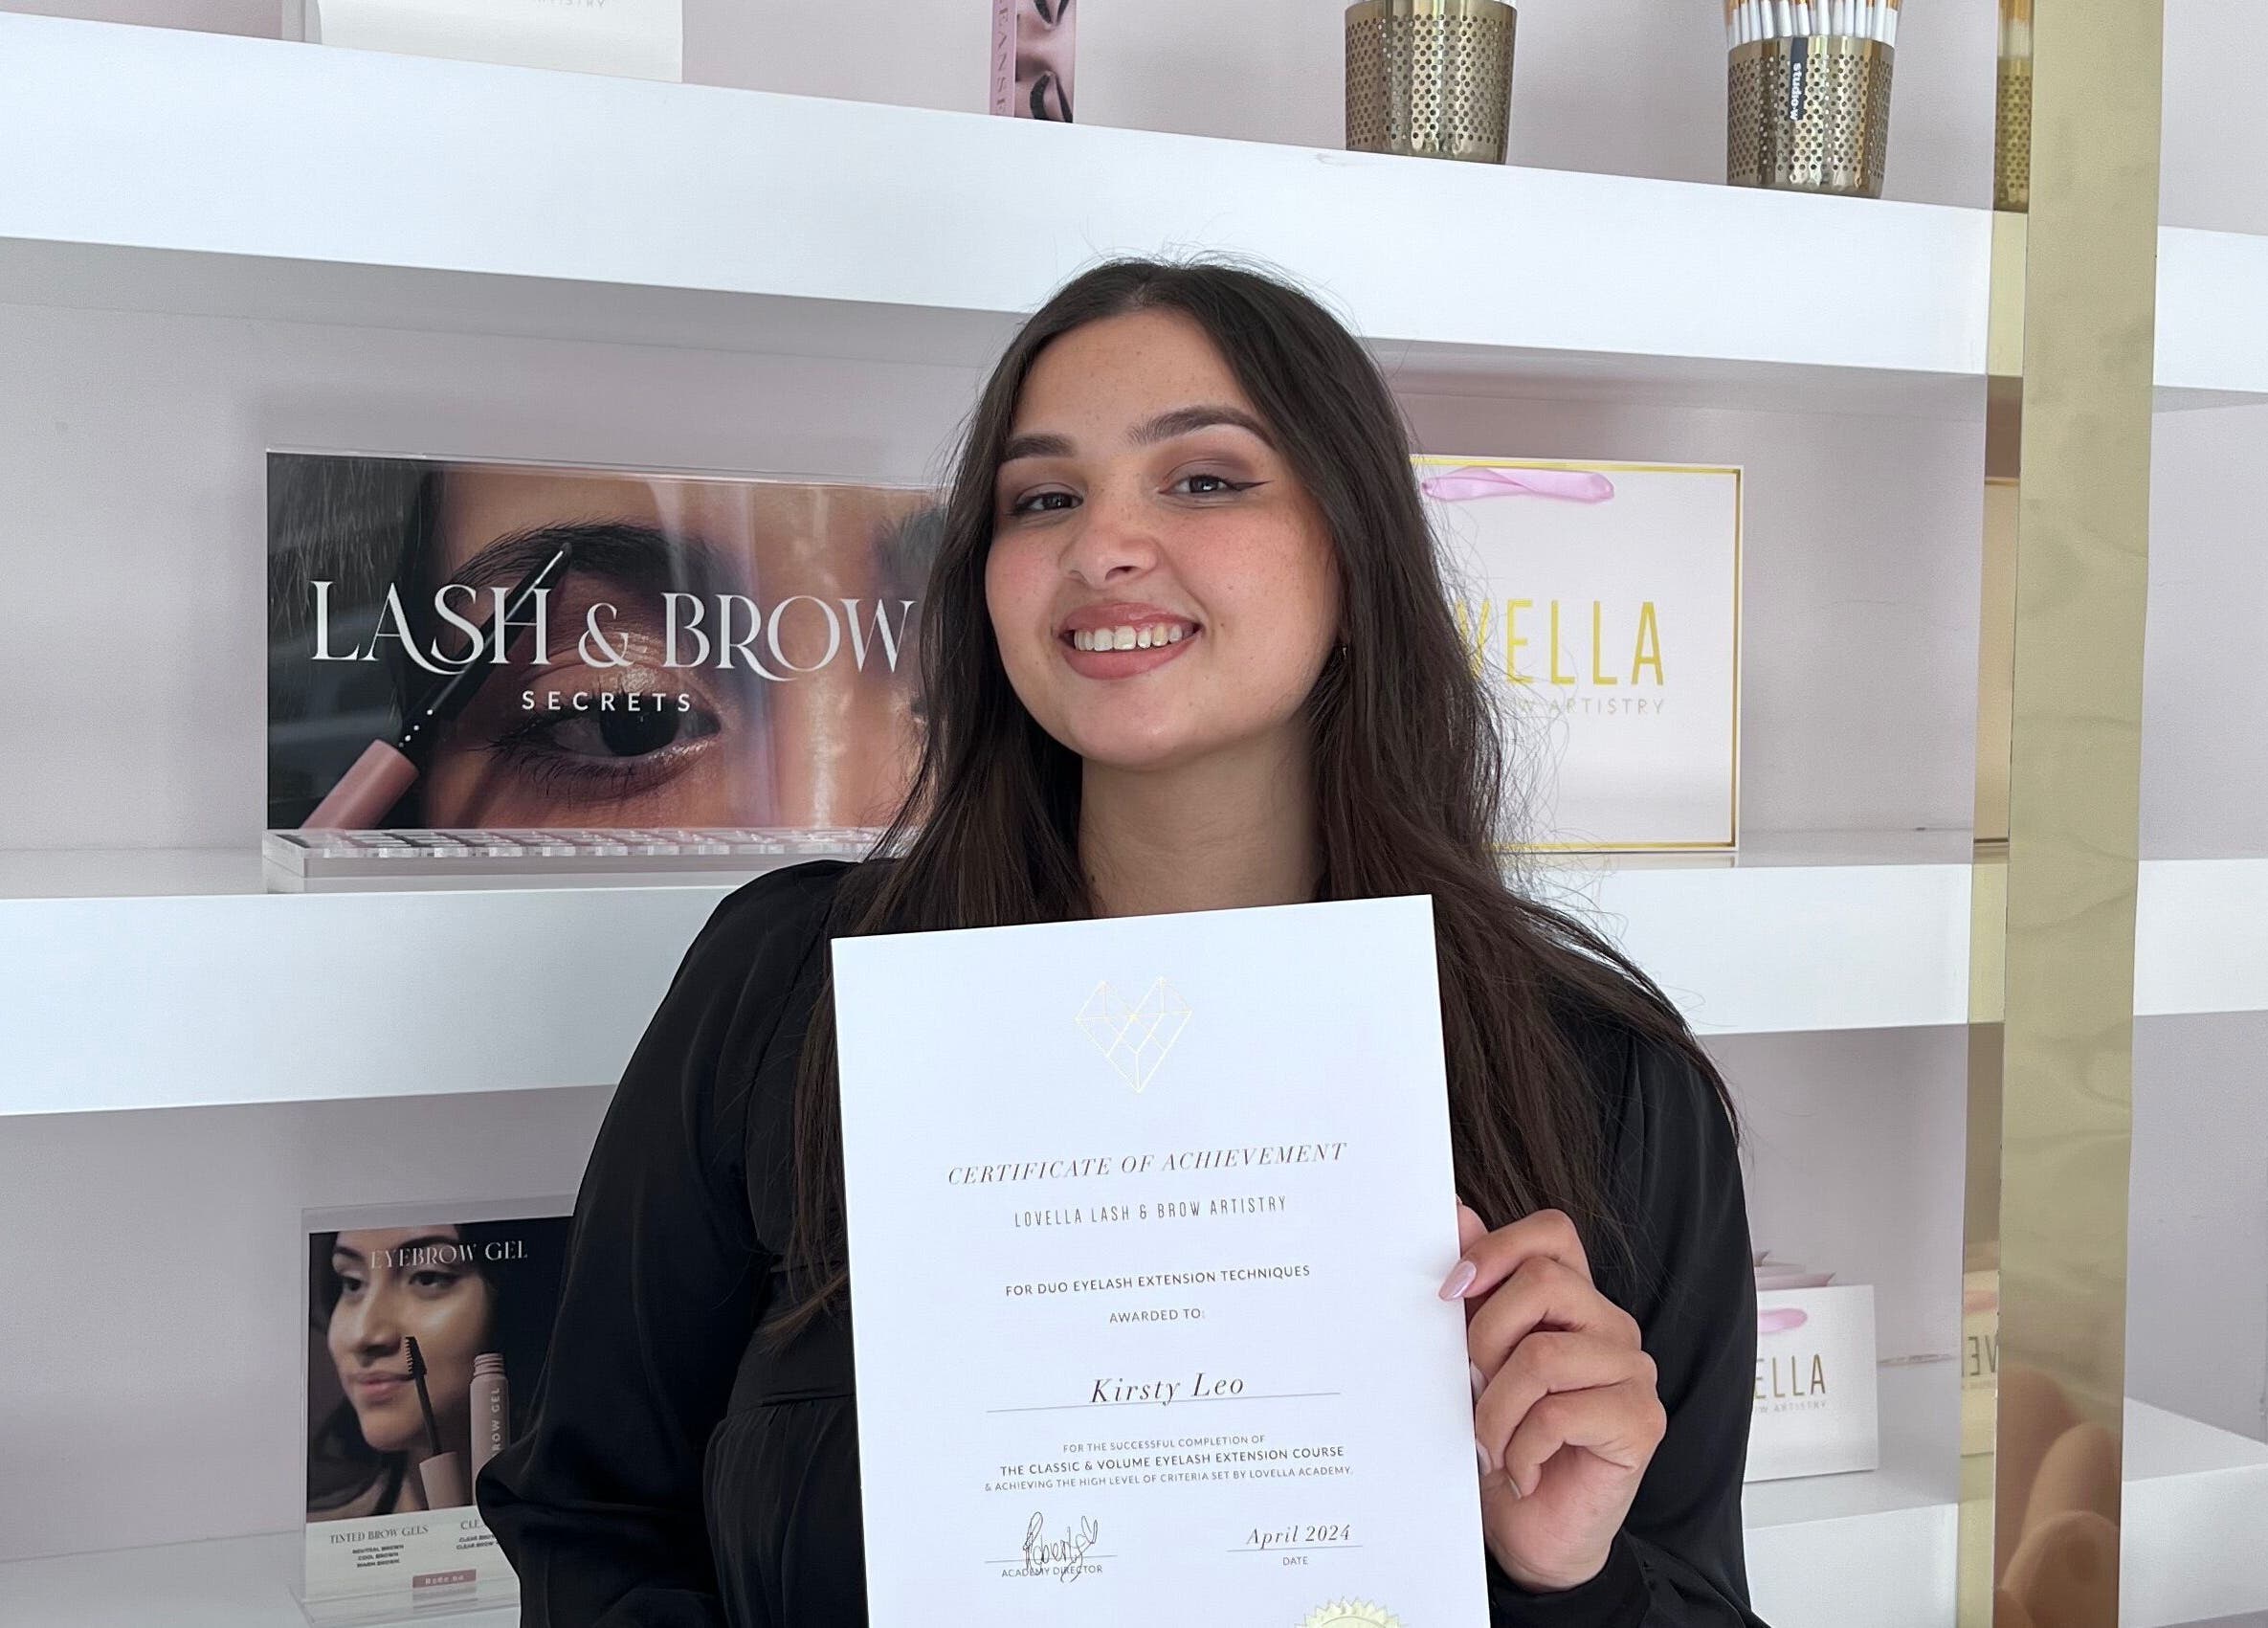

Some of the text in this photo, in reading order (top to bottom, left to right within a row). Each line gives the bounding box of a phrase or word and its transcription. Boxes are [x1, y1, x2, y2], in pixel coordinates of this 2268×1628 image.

[309, 579, 917, 681] LASH & BROW
[522, 689, 692, 712] SECRETS
[947, 1142, 1347, 1186] CERTIFICATE OF ACHIEVEMENT
[1013, 1195, 1287, 1228] LOVELLA LASH & BROW ARTISTRY
[370, 1239, 528, 1269] EYEBROW GEL
[1005, 1264, 1310, 1297] FOR DUO EYELASH EXTENSION TECHNIQUES
[1109, 1308, 1178, 1324] AWARDED
[1089, 1372, 1244, 1406] Kirsty Leo
[1062, 1435, 1265, 1454] FOR THE SUCCESSFUL COMPLETION OF
[1000, 1445, 1345, 1477] THE CLASSIC & VOLUME EYELASH EXTENSION COURSE
[985, 1483, 992, 1492] &
[994, 1479, 1054, 1491] ACHIEVING
[1056, 1478, 1077, 1488] THE
[1079, 1477, 1106, 1486] HIGH
[1109, 1475, 1140, 1485] LEVEL
[1143, 1474, 1157, 1483] OF
[1160, 1472, 1209, 1483] CRITERIA
[1212, 1470, 1230, 1481] SET
[1233, 1470, 1246, 1480] BY
[1249, 1467, 1296, 1479] LOVELLA
[367, 1528, 397, 1541] BROW
[1246, 1524, 1351, 1550] April 2024
[1001, 1564, 1103, 1577] ACADEMY DIRECTOR
[1282, 1556, 1309, 1566] DATE
